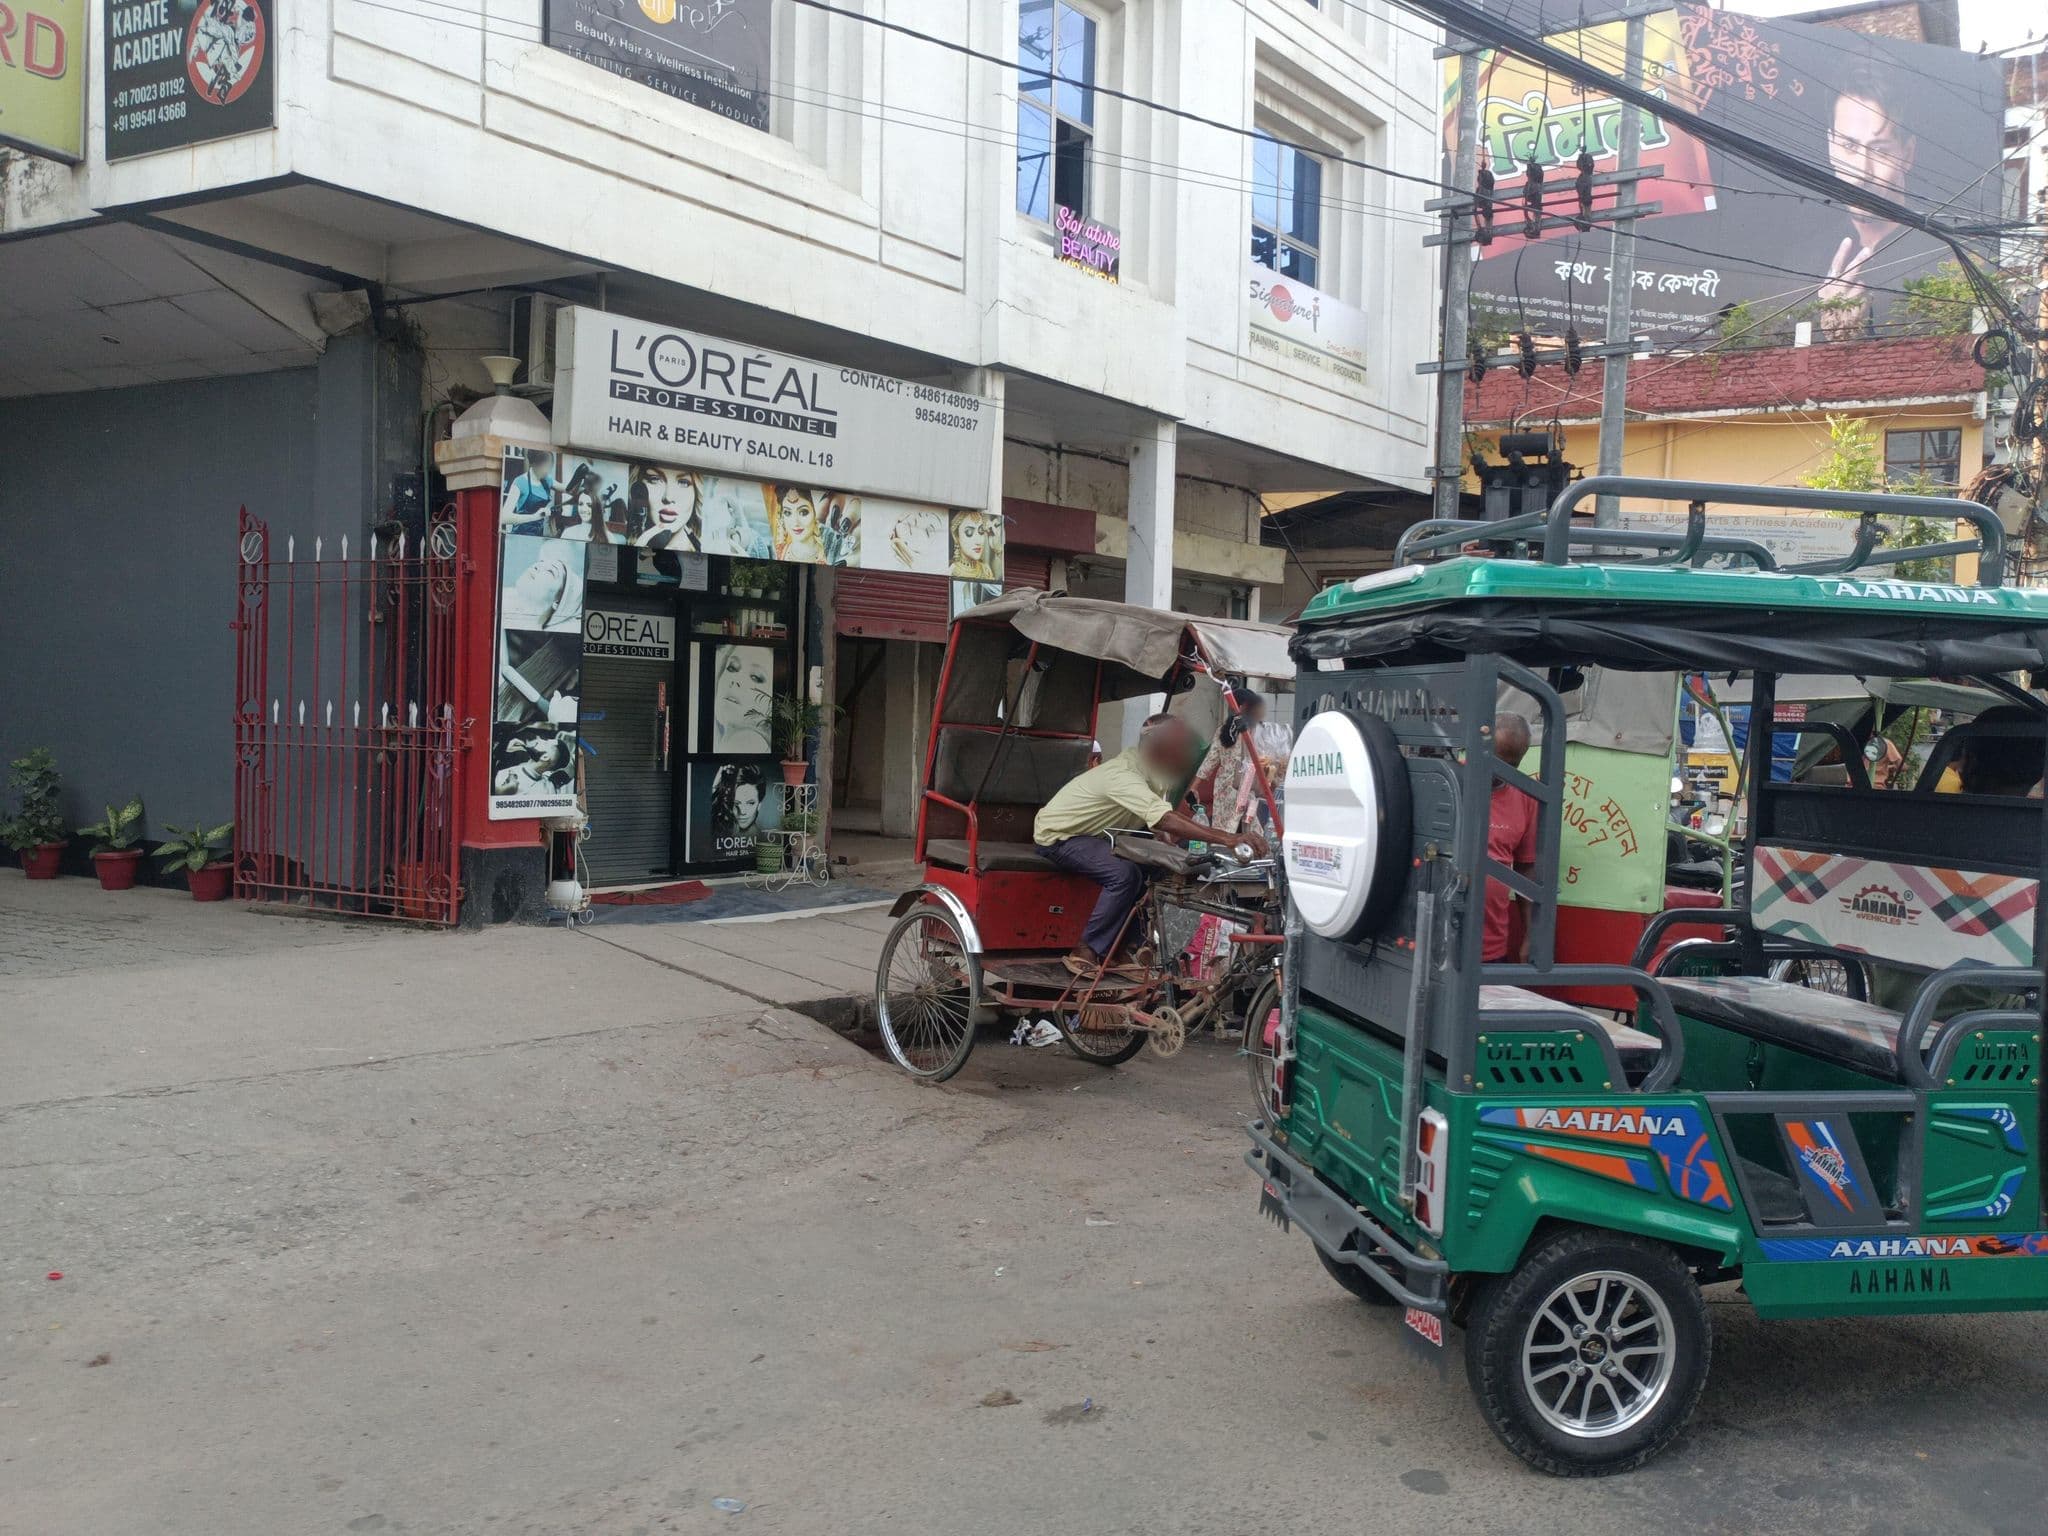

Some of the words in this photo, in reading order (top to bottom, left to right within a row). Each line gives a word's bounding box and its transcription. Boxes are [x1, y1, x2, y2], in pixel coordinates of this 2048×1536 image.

[113, 0, 169, 38] KARATE
[113, 27, 183, 71] ACADEMY
[575, 20, 617, 48] Beauty,
[619, 37, 643, 56] Hair
[644, 47, 654, 60] &
[656, 52, 702, 80] Wellness
[703, 70, 752, 100] Institution
[567, 44, 633, 79] TRAINING
[647, 75, 698, 104] SERVICE
[113, 91, 128, 108] +91
[130, 83, 158, 105] 70023
[160, 77, 185, 98] 81192
[113, 115, 128, 132] +91
[130, 108, 156, 129] 99541
[158, 101, 186, 122] 43668
[1062, 237, 1114, 272] BEAUTY
[1555, 261, 1597, 284] কথা
[611, 329, 837, 417] L'ORÉAL
[659, 354, 686, 367] PARIS
[840, 368, 903, 395] CONTACT
[913, 385, 980, 412] 8486148099
[615, 382, 834, 437] PROFESSIONNEL
[915, 407, 979, 432] 9854820387
[608, 416, 652, 438] HAIR
[657, 424, 669, 441] &
[674, 428, 742, 452] BEAUTY
[747, 440, 804, 464] SALON.
[809, 450, 834, 468] L18
[1744, 516, 1788, 528] Fitness
[1790, 517, 1845, 531] Academy
[1836, 583, 1998, 605] AAHANA
[1292, 752, 1344, 777] AAHANA
[1852, 897, 1907, 920] AAHANA
[1487, 1042, 1575, 1061] ULTRA
[1974, 1043, 2029, 1061] ULTRA
[1536, 1109, 1687, 1137] AAHANA
[1811, 1152, 1843, 1181] AAHANA
[1830, 1237, 1972, 1258] AAHANA
[1850, 1267, 1952, 1295] AAHANA
